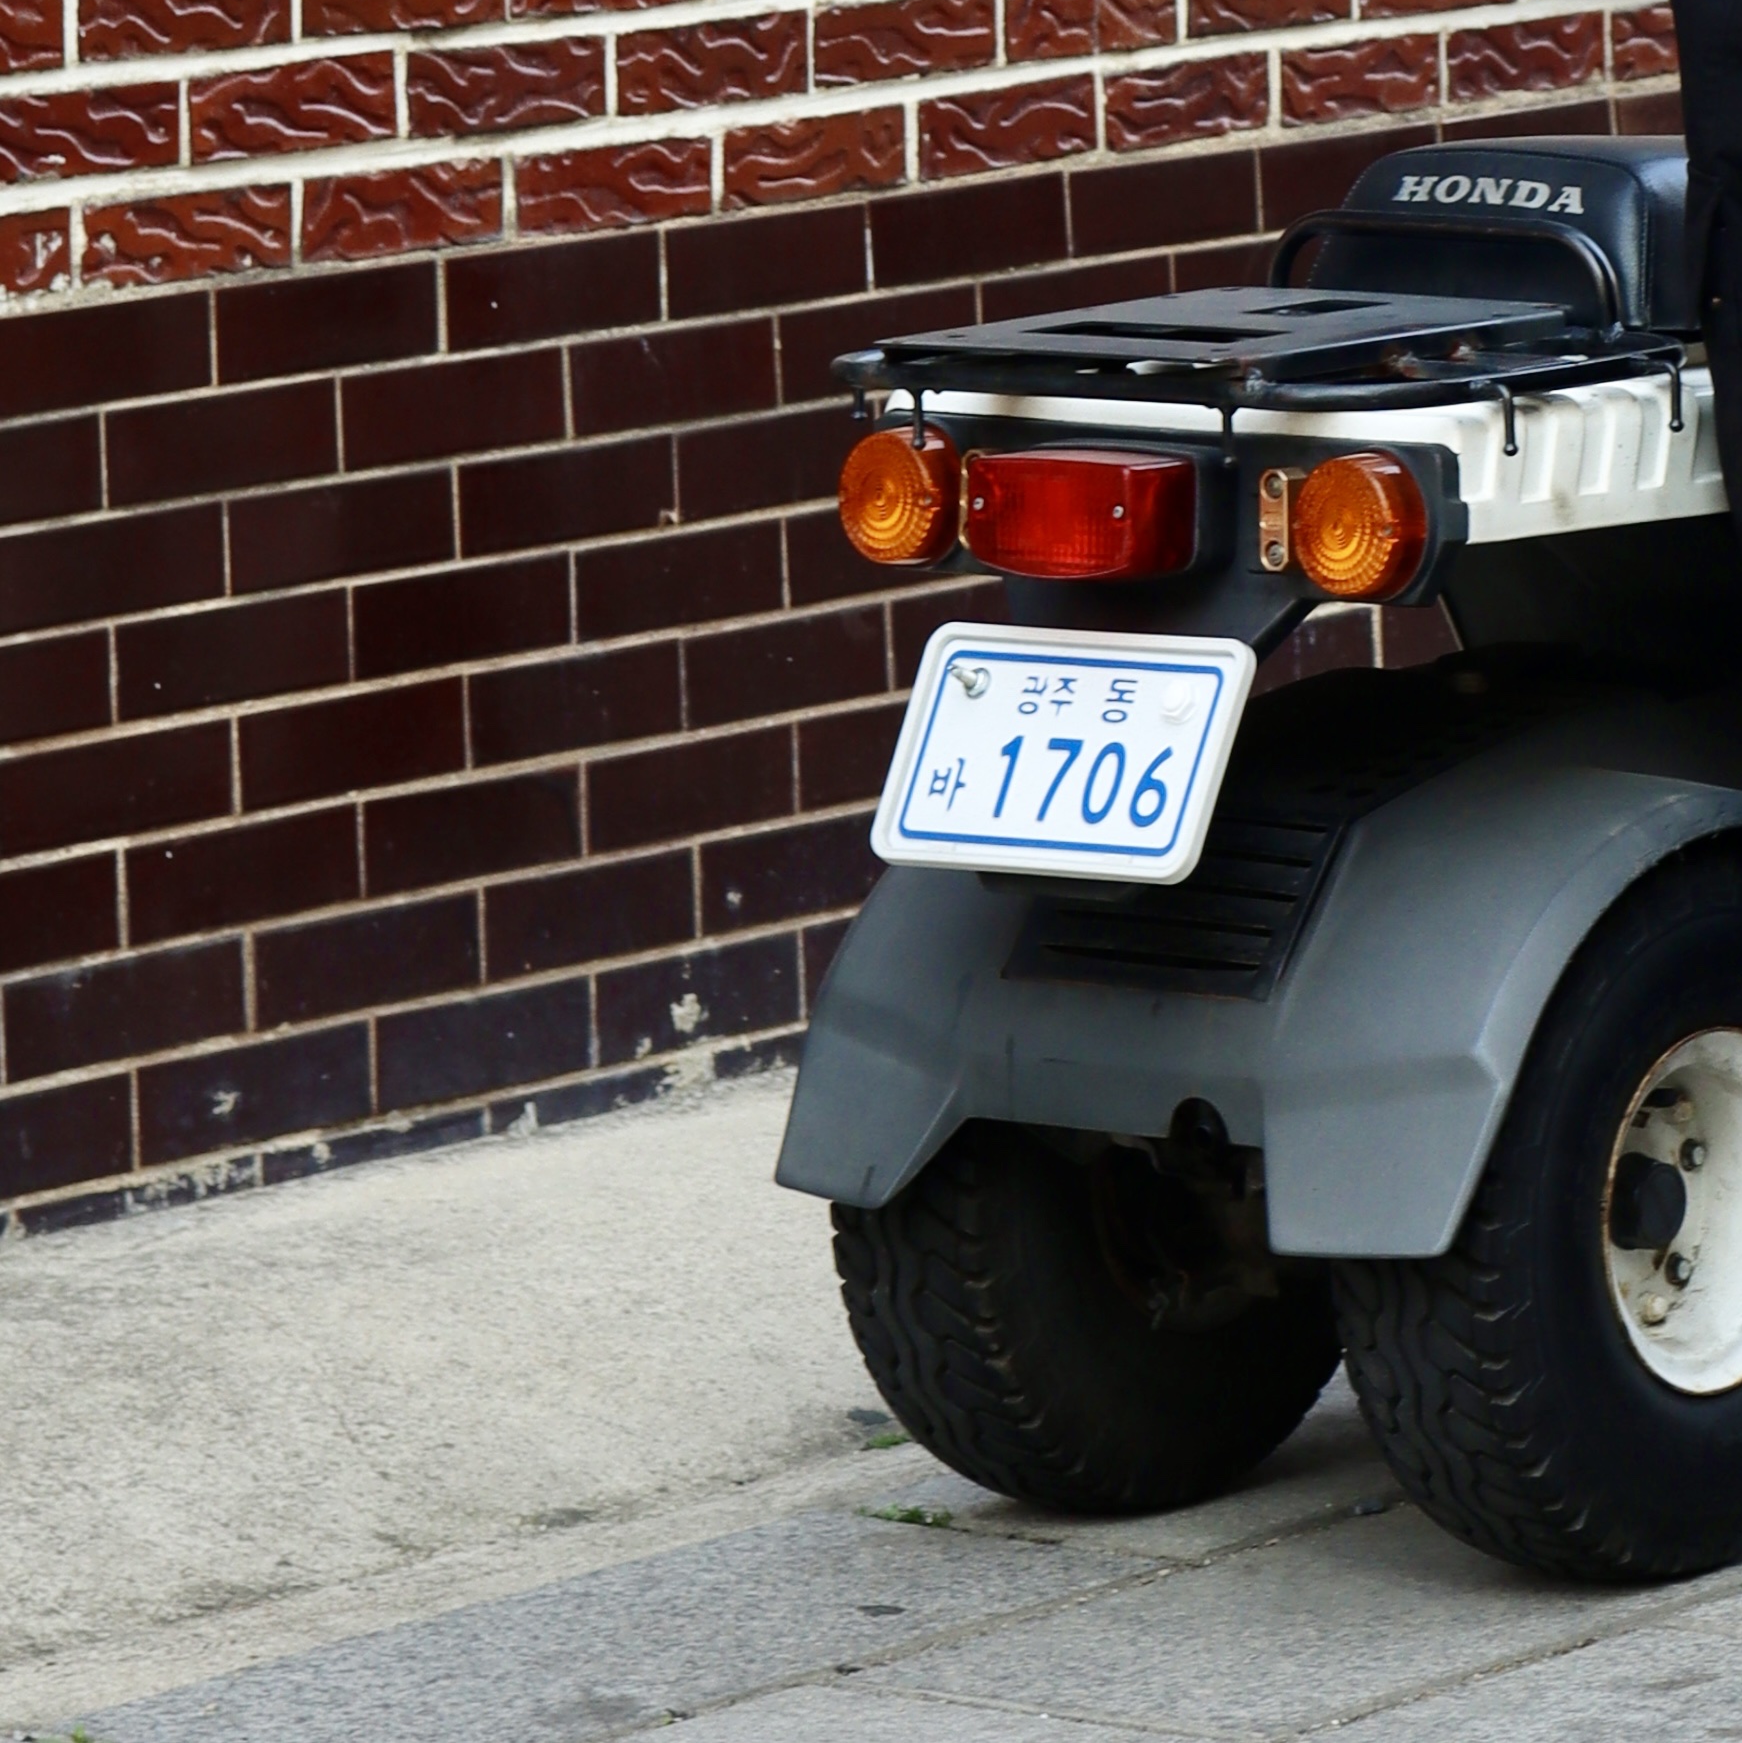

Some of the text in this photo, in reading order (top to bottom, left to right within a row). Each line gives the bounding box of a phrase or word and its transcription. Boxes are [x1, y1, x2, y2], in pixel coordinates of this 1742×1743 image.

[1392, 175, 1585, 215] HONDA
[1017, 674, 1138, 724] 광주 동
[928, 734, 1174, 829] 바 1706
